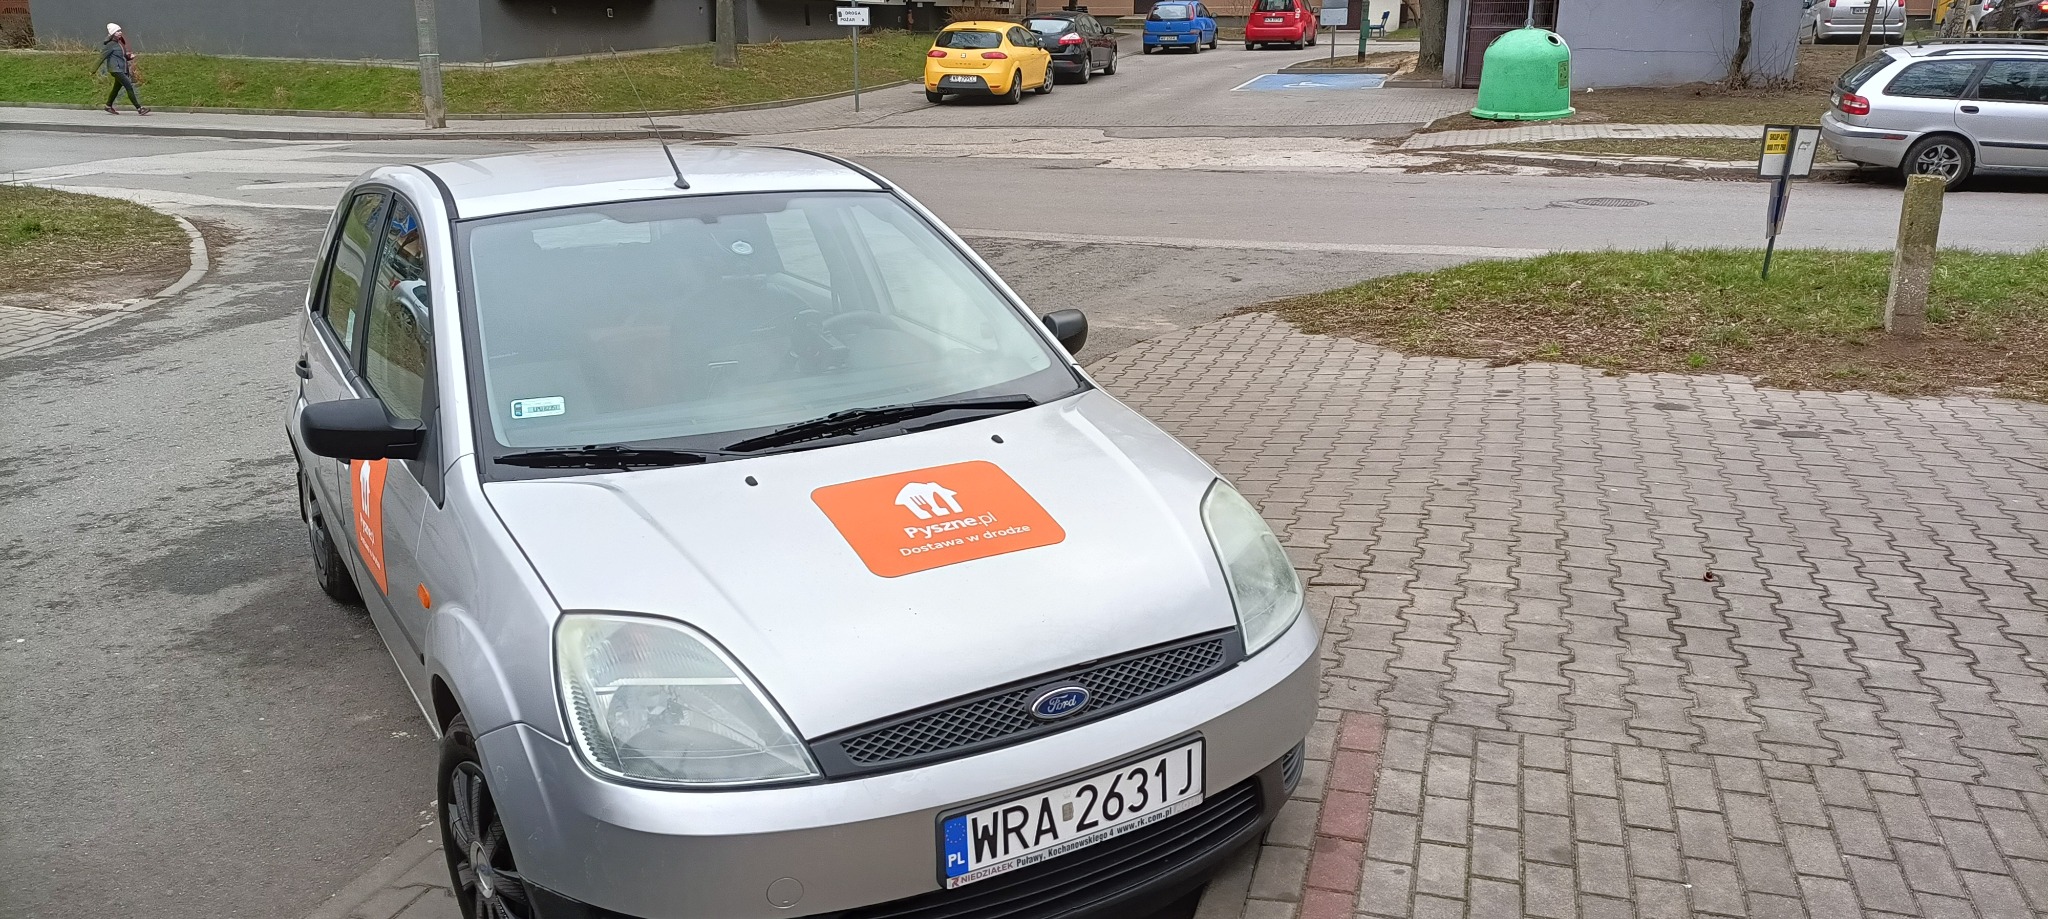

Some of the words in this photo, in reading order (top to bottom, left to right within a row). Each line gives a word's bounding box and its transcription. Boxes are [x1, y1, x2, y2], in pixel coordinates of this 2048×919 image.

[903, 512, 998, 539] Pyszne.pl
[899, 538, 965, 556] Dostawa
[965, 534, 980, 543] w
[982, 525, 1031, 539] drodze
[1047, 694, 1077, 713] Ford
[971, 796, 1059, 864] WRA
[1075, 748, 1193, 833] 2631J
[947, 851, 965, 867] PL
[960, 861, 1014, 884] NIEDZIAŁEK
[1048, 832, 1108, 857] Kochanowskiego
[1109, 828, 1114, 836] 4
[1116, 807, 1172, 833] www.rk.com.pl
